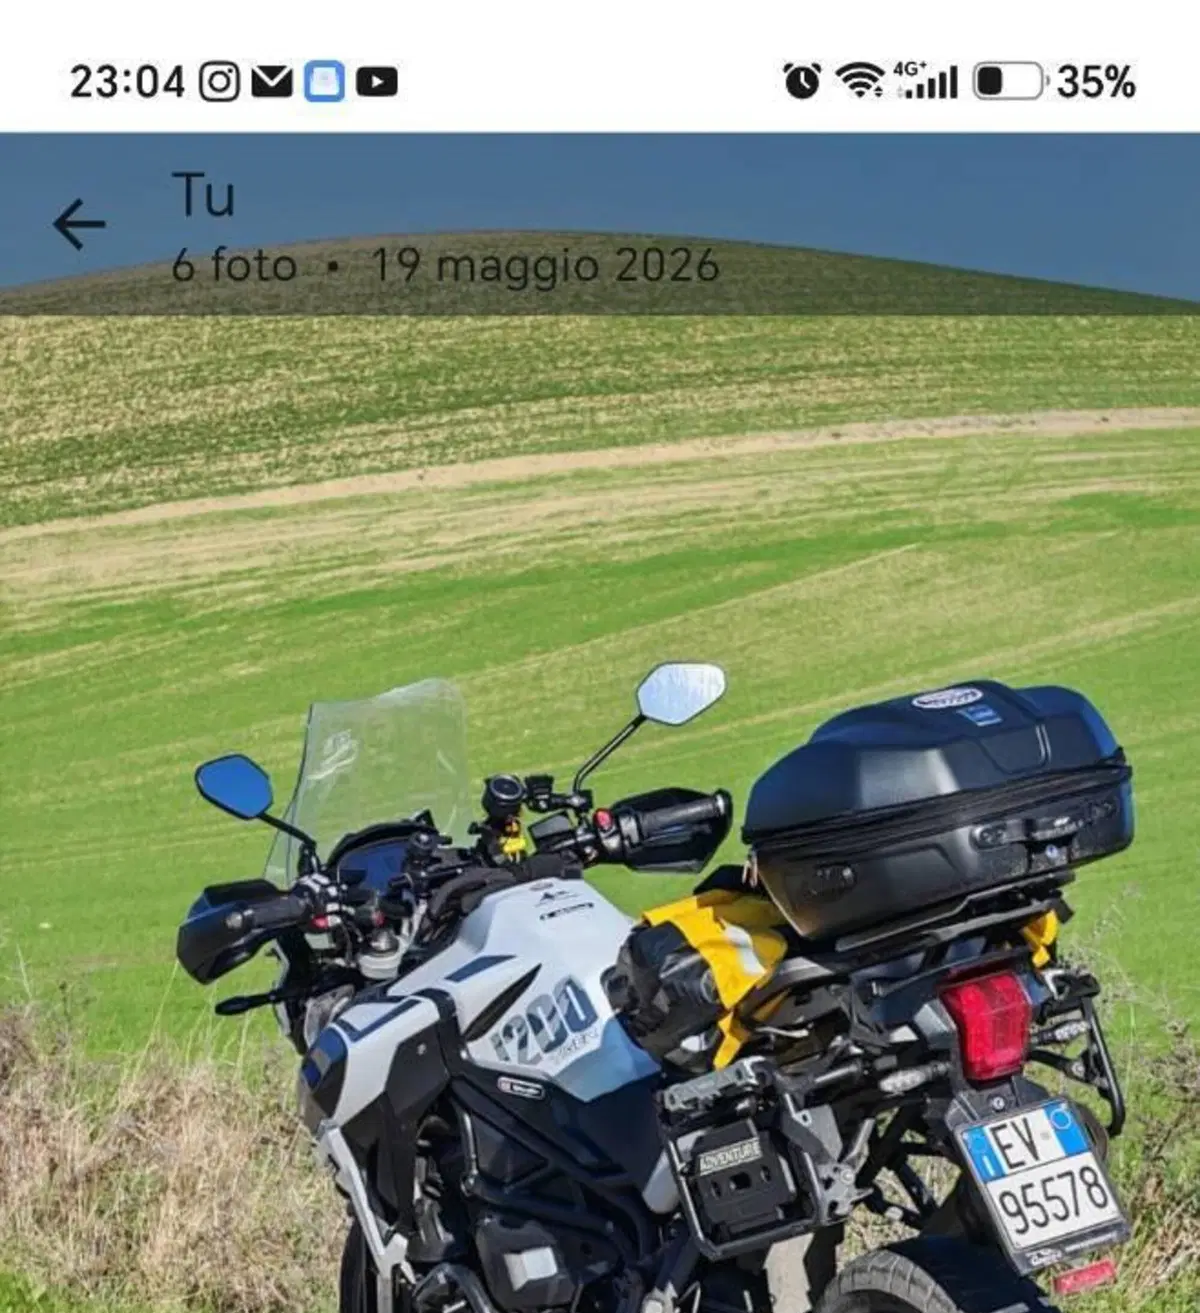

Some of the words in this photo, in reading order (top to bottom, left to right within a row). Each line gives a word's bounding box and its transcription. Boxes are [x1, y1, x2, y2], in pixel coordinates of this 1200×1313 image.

[490, 975, 599, 1066] 1200
[701, 1140, 760, 1172] ADVENTURE
[990, 1117, 1040, 1170] EV
[1000, 1166, 1108, 1235] 95578
